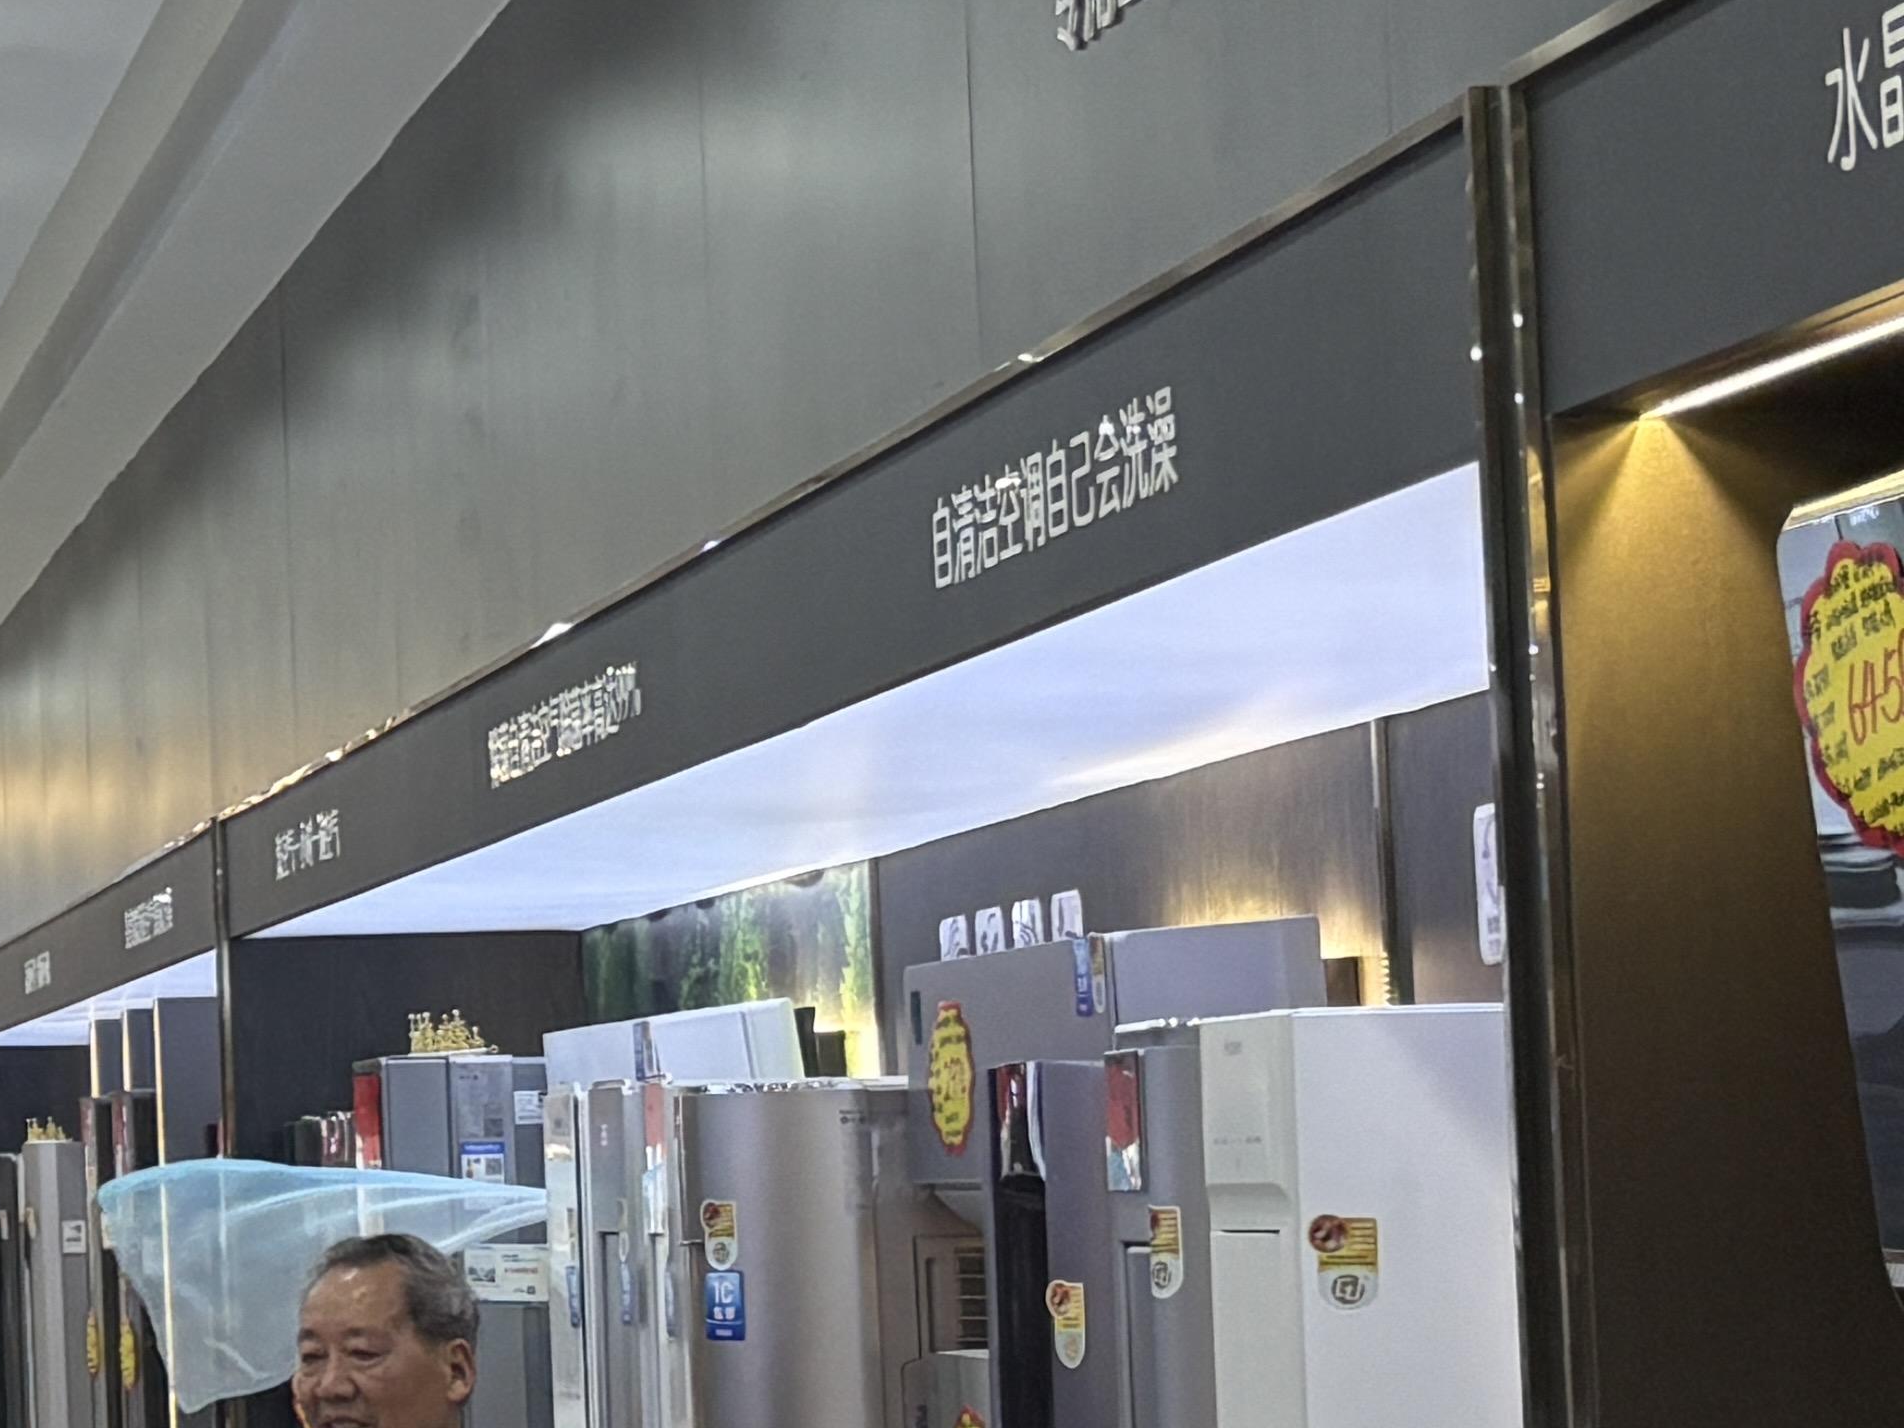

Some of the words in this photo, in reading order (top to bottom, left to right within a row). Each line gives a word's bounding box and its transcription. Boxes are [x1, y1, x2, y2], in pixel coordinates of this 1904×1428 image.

[932, 386, 1178, 589] 自清洁空调自己会洗澡
[1847, 627, 1904, 746] 645
